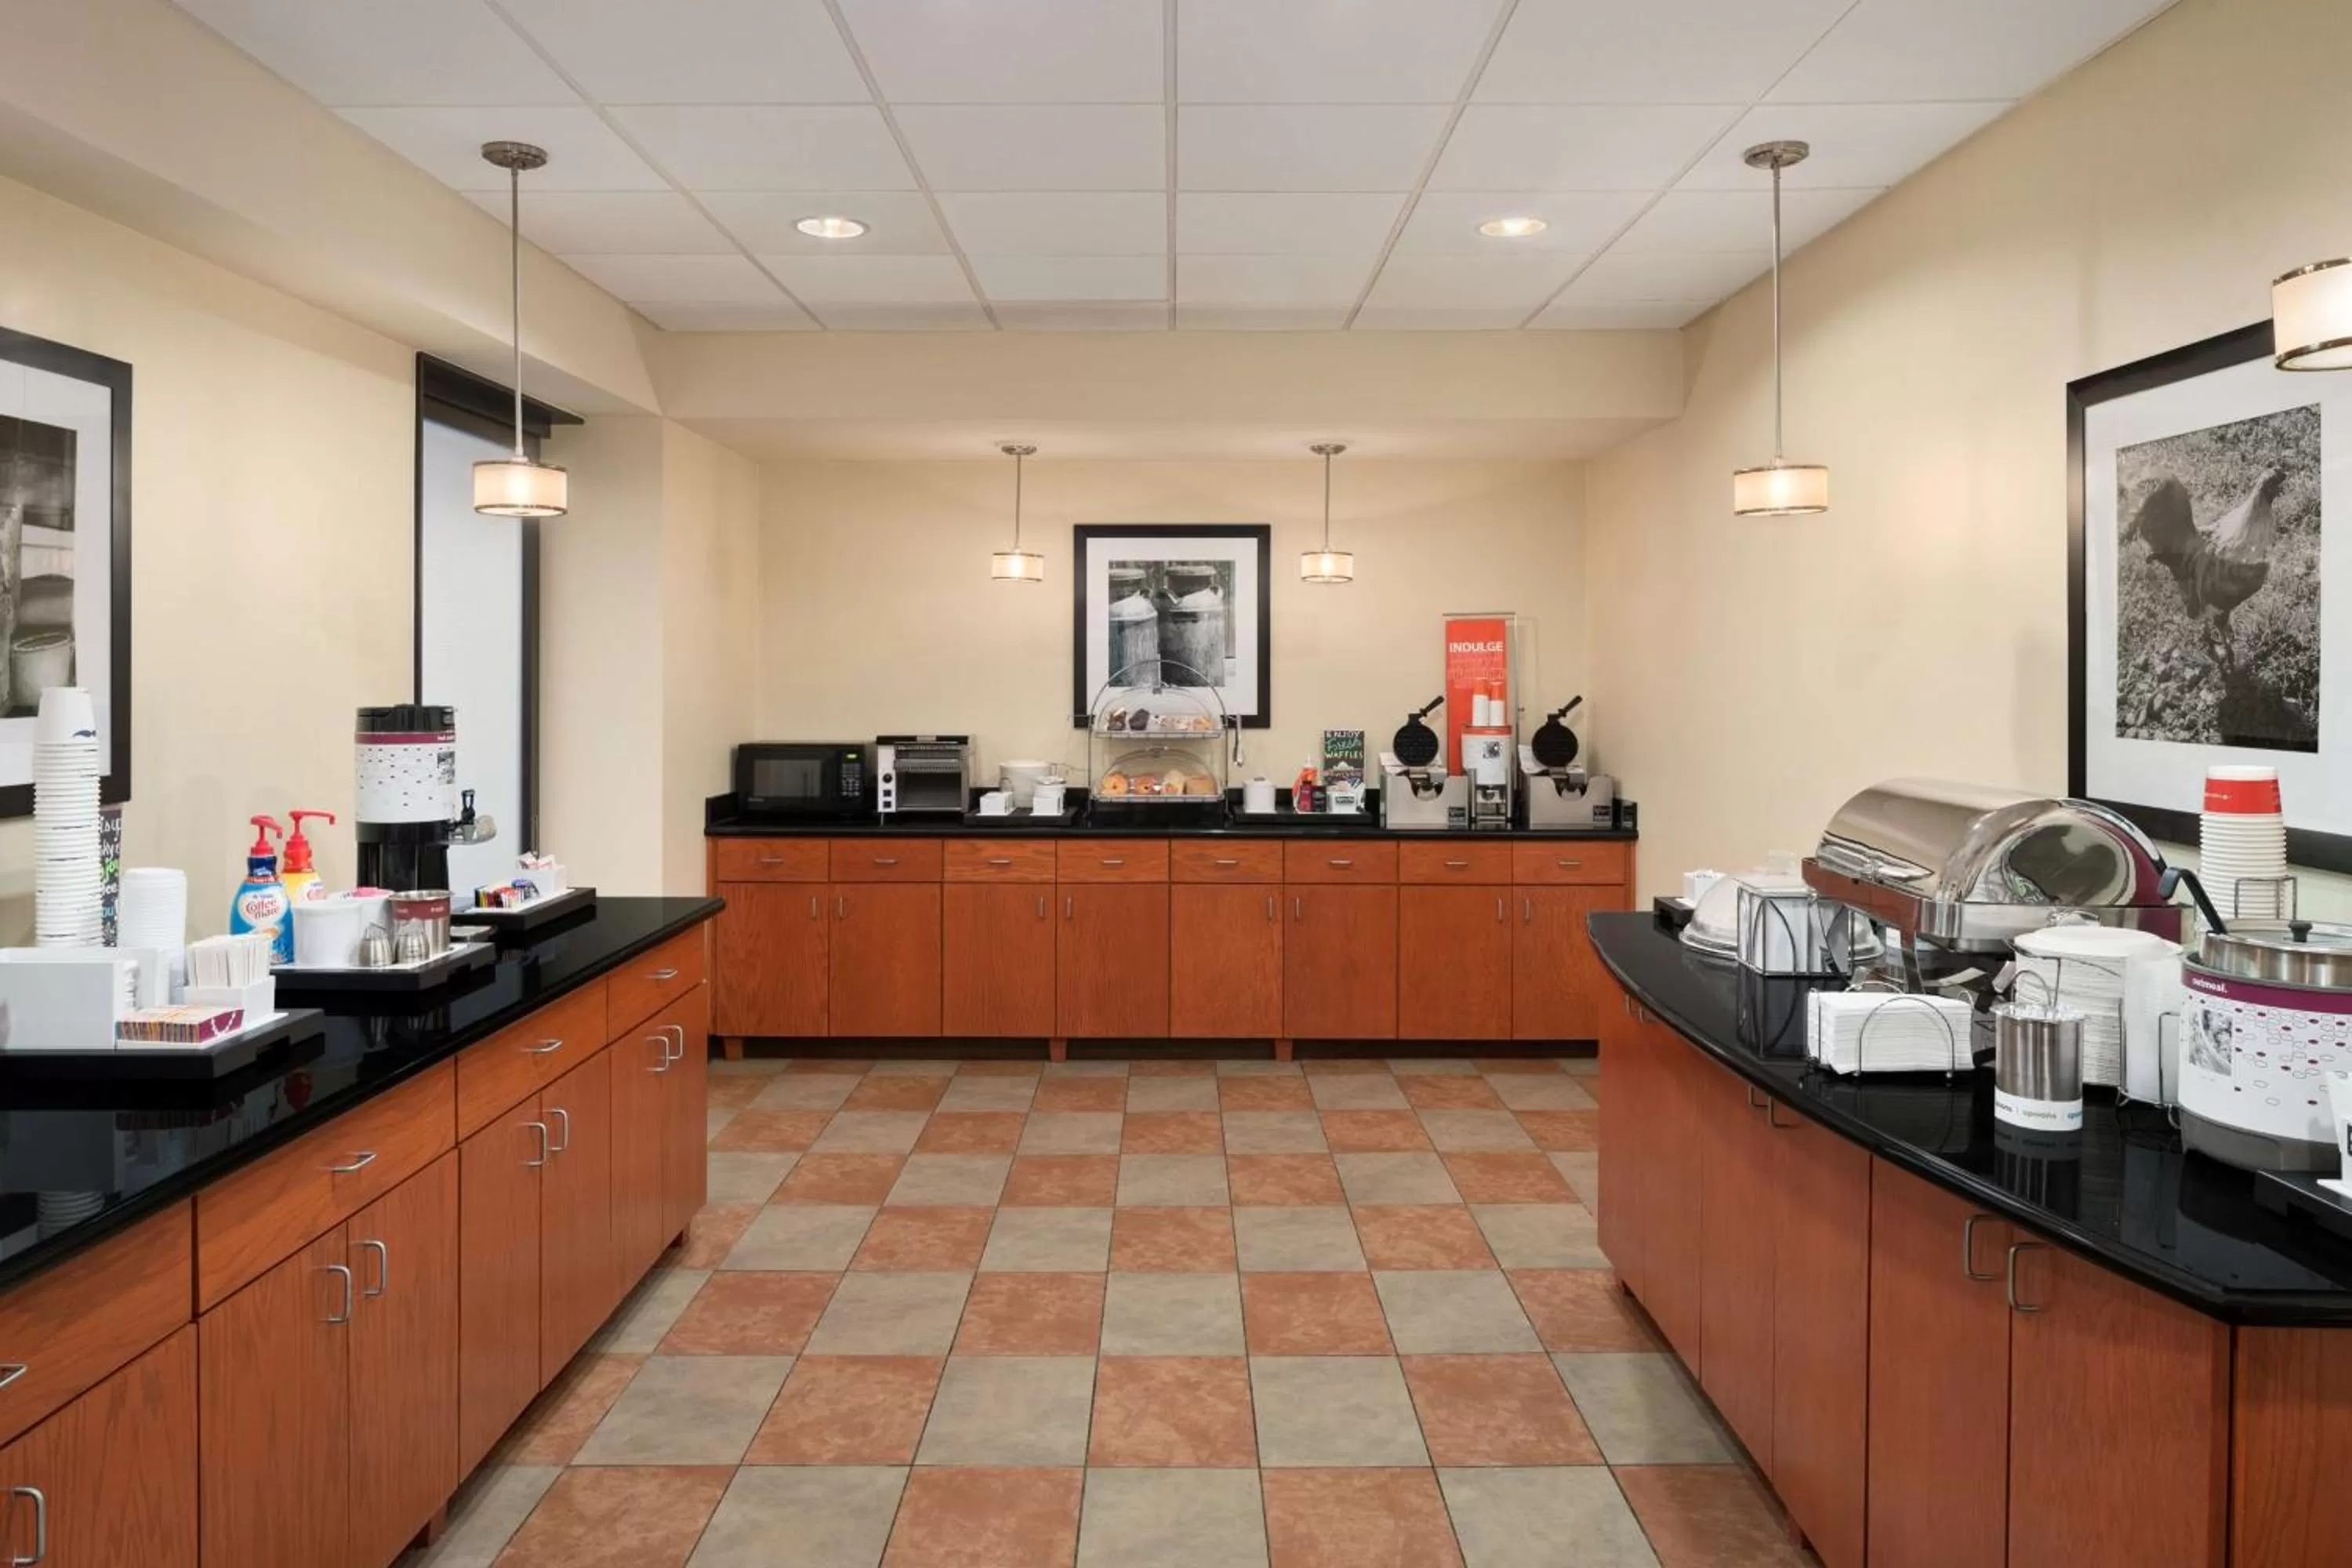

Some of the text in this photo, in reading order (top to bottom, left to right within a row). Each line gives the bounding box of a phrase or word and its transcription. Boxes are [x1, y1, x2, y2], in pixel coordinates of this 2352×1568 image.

[1449, 641, 1504, 653] INDULGE
[1325, 750, 1363, 760] WAFFLES
[245, 898, 277, 915] Coffee
